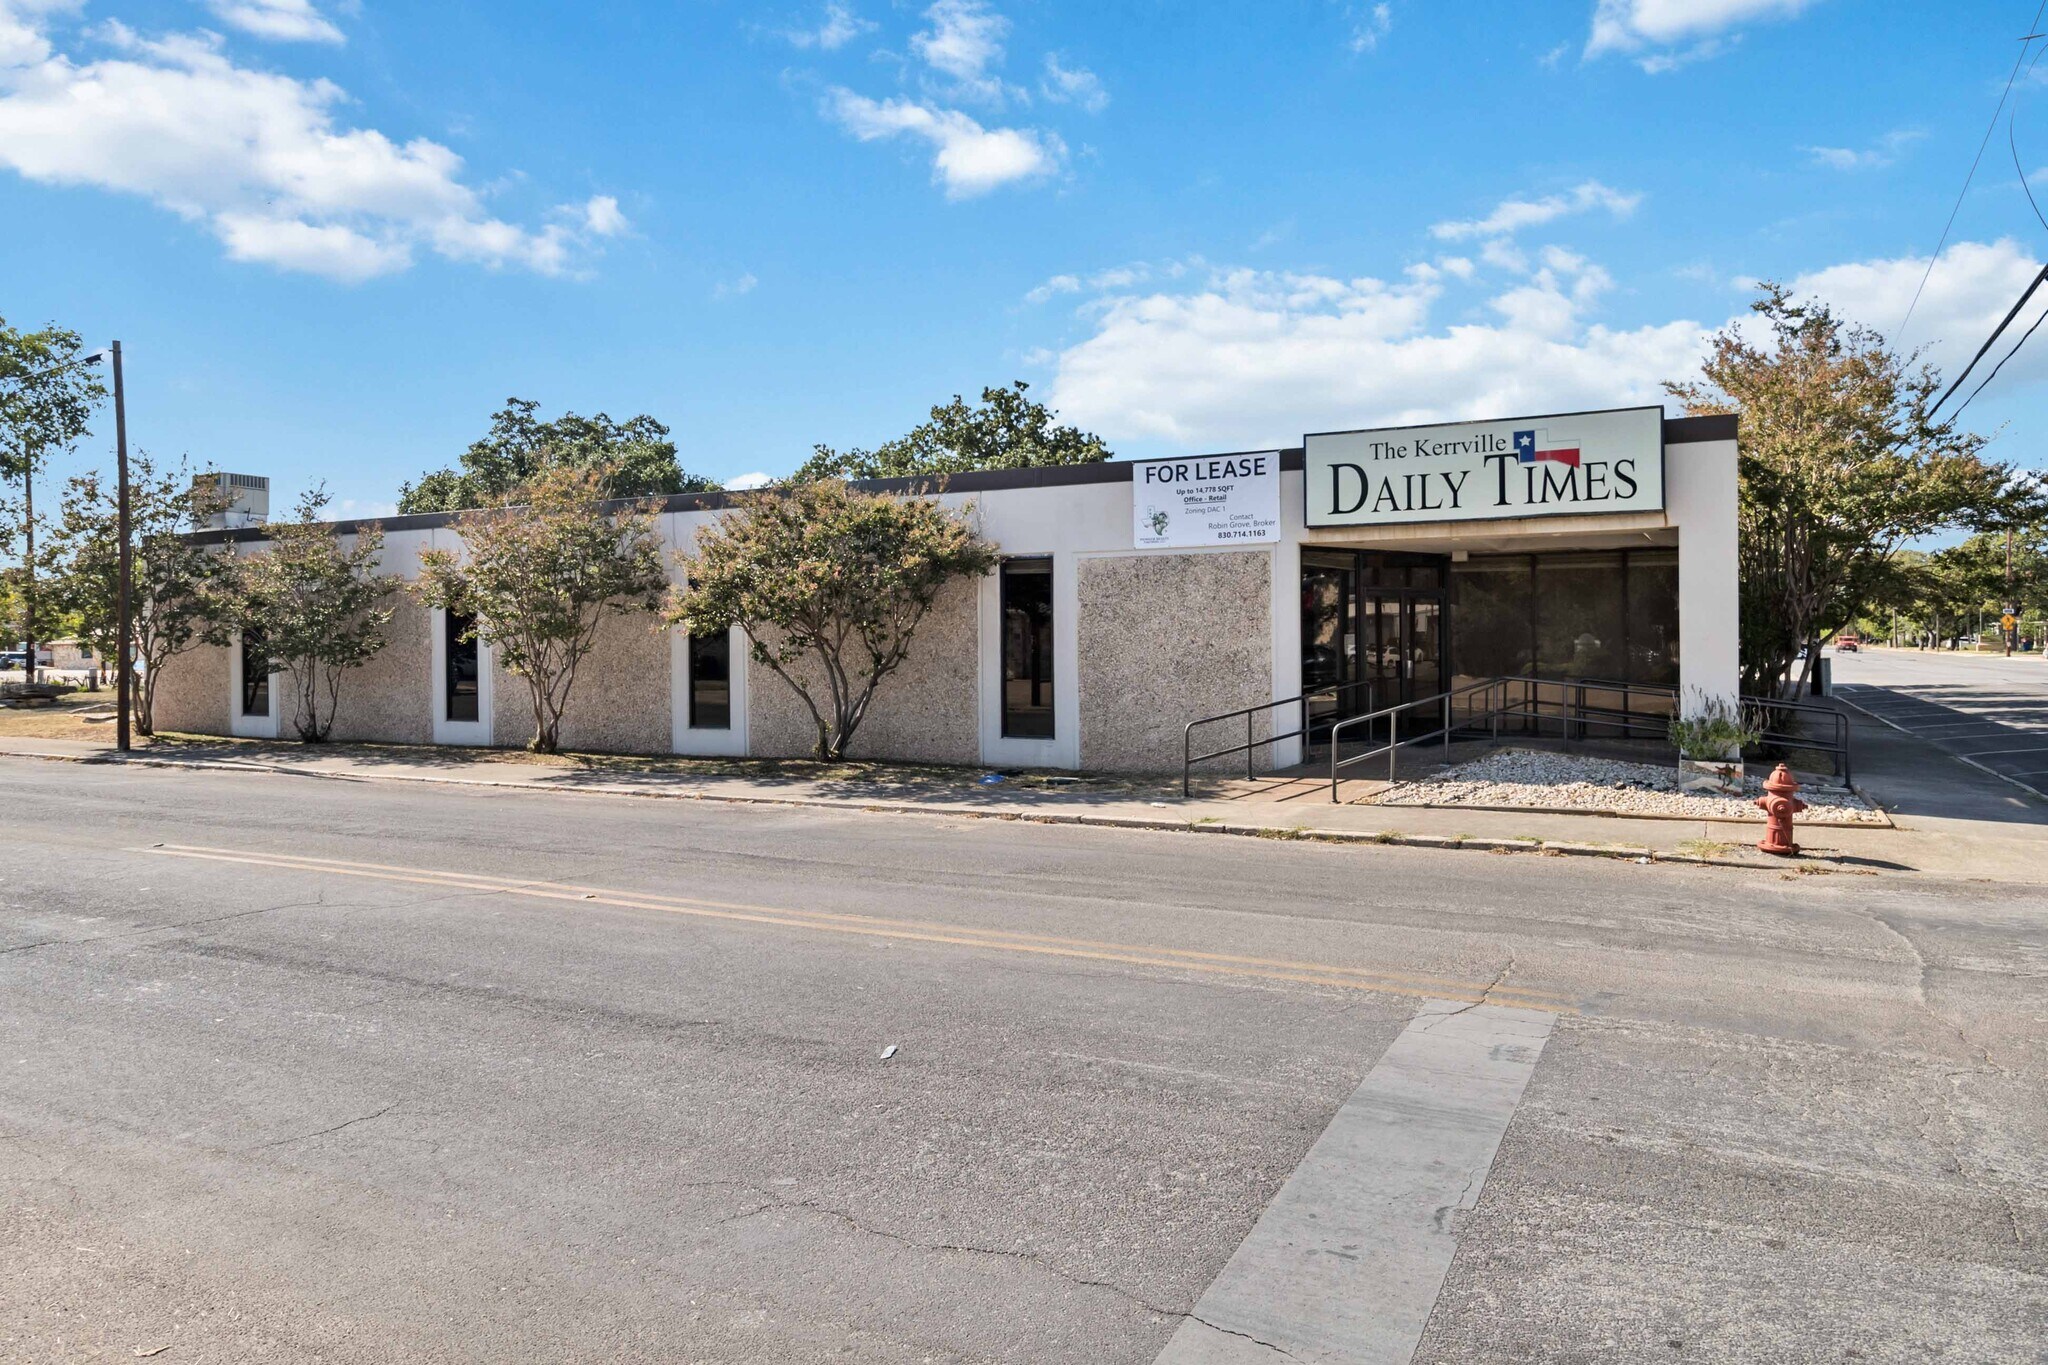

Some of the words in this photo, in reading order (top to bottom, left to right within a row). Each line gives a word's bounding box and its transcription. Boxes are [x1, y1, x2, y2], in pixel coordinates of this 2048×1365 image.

[1369, 442, 1407, 461] The
[1414, 434, 1508, 458] Kerrville
[1146, 464, 1189, 484] FOR
[1196, 457, 1266, 481] LEASE
[1327, 462, 1472, 516] DAILY
[1483, 452, 1639, 507] TIMES
[1185, 507, 1206, 515] Zoning
[1230, 520, 1251, 529] Grove,
[1218, 530, 1266, 539] 830.714.1163
